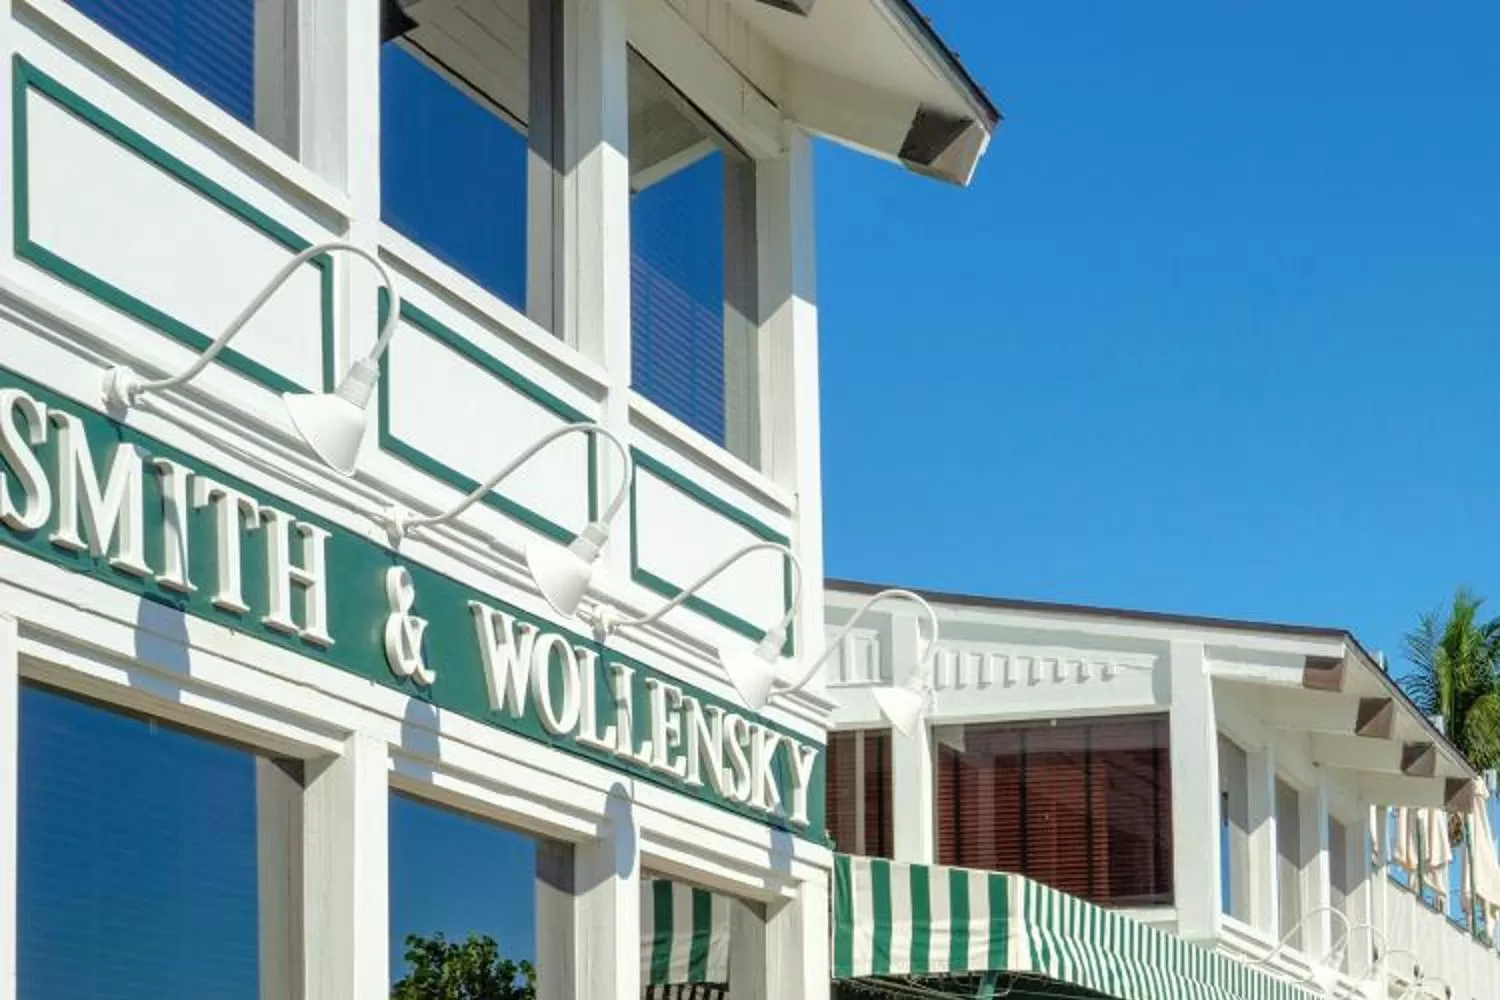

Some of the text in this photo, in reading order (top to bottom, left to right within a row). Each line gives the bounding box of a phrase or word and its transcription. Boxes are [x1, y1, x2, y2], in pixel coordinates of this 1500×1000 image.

[0, 388, 819, 827] SMITH & WOLLENSKY
